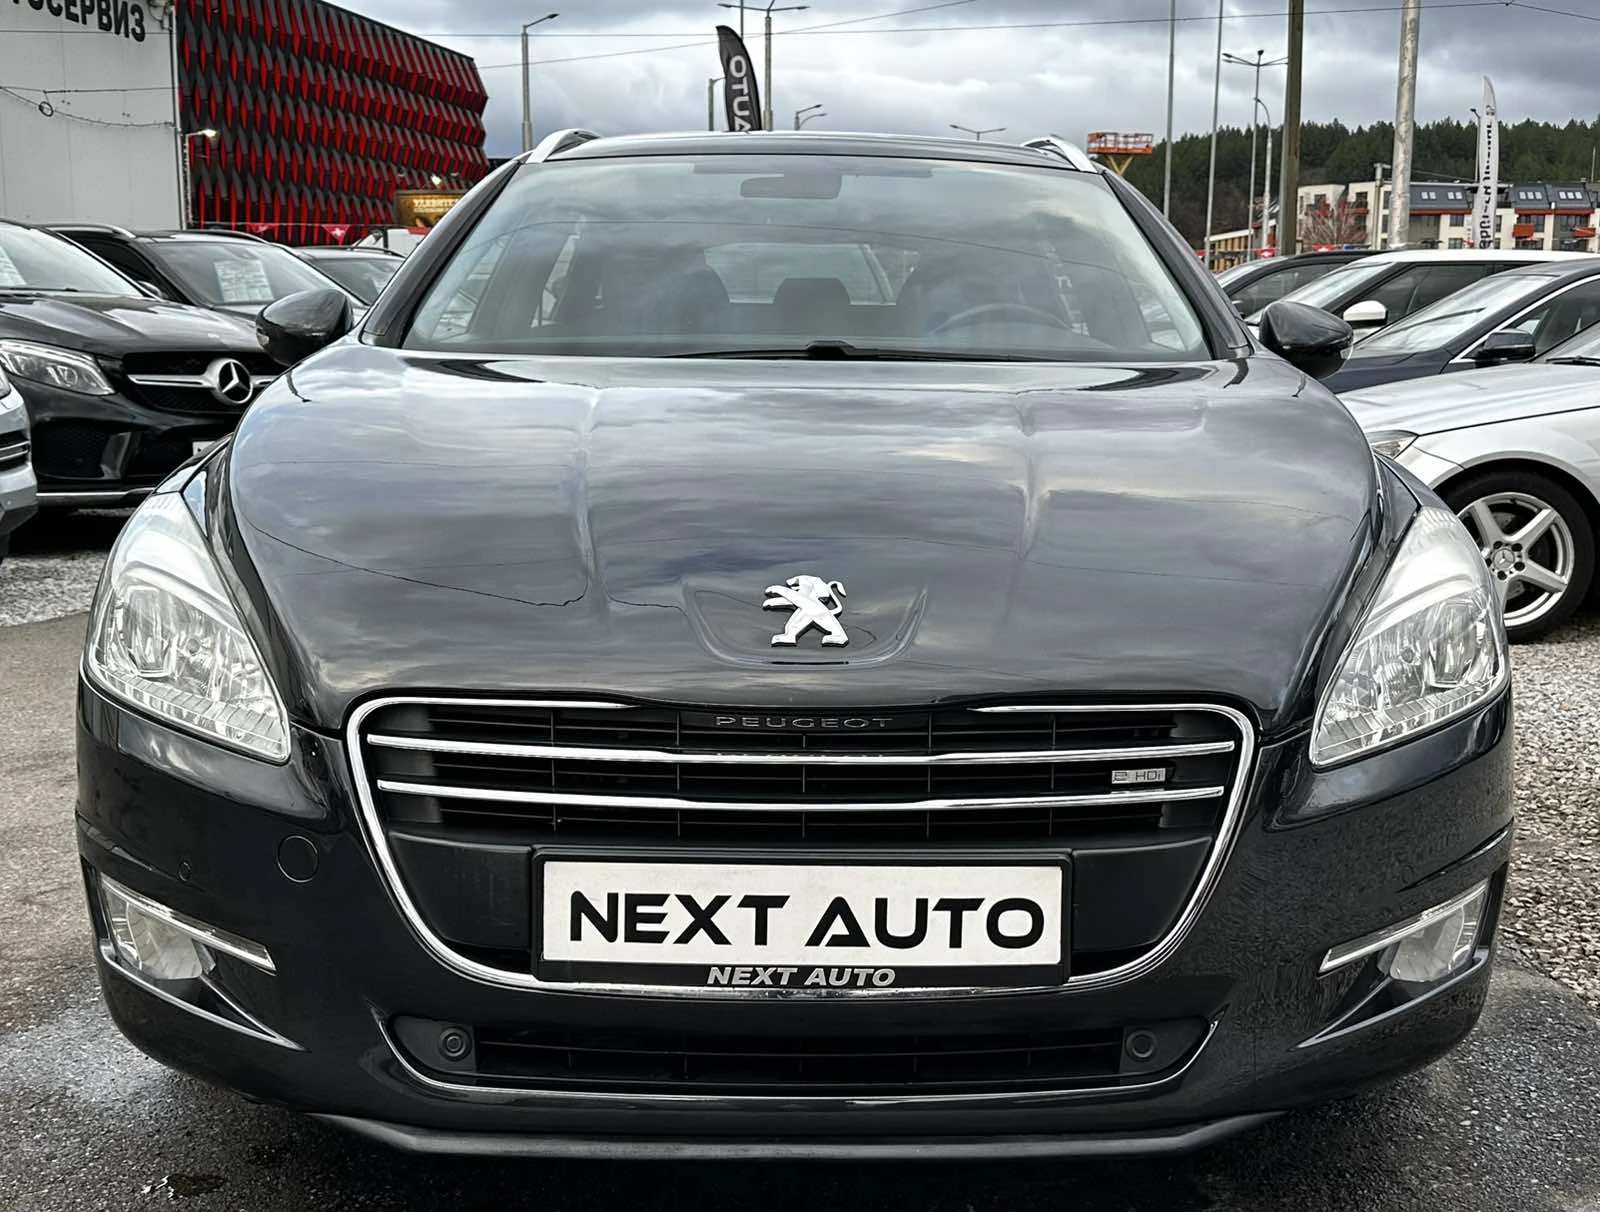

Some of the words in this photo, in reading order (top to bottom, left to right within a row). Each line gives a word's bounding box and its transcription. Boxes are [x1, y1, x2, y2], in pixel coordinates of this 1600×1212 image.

[715, 716, 893, 728] PEUGEOT
[570, 890, 789, 947] NEXT
[805, 895, 1045, 949] AUTO
[707, 967, 802, 987] NEXT
[805, 968, 896, 987] AUTO
